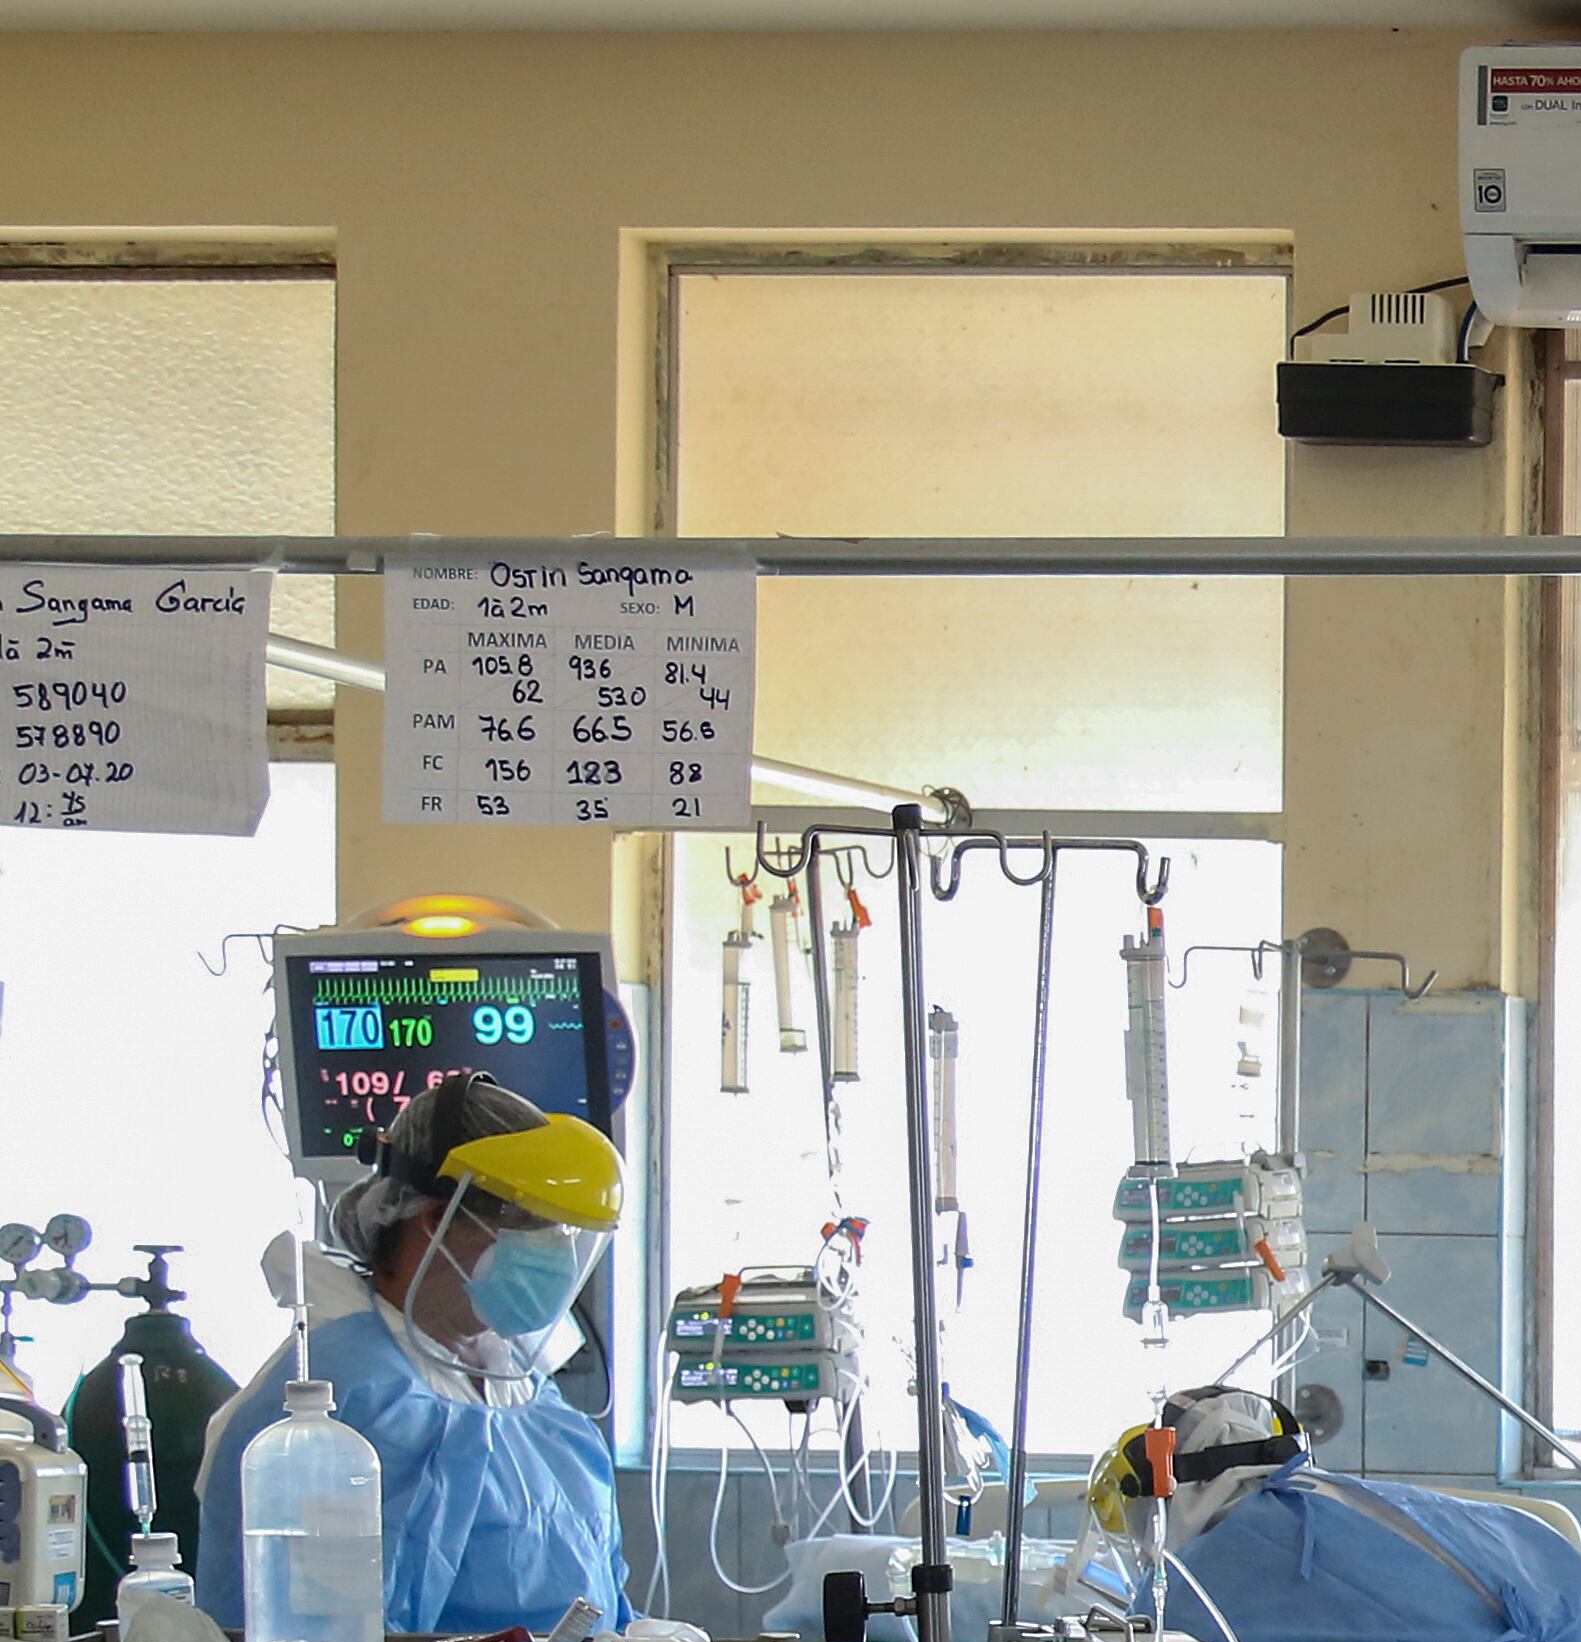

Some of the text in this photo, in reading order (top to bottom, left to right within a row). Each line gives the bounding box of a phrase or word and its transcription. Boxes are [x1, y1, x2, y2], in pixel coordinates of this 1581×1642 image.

[1493, 75, 1528, 87] HASTA
[1530, 74, 1554, 87] 70%
[1535, 99, 1568, 111] DUAL
[412, 567, 478, 580] NOMBRE:
[16, 580, 132, 625] Sangama
[412, 598, 455, 611] EDAD:
[619, 594, 695, 617] SEXO: M
[467, 632, 741, 653] MAXIMA MEDIA MINIMA
[423, 658, 447, 674] PA
[664, 661, 707, 686] 81.4
[13, 681, 126, 711] 589040
[512, 679, 544, 704] 62
[699, 687, 731, 712] 44
[16, 720, 121, 748] 578890
[412, 713, 455, 730] PAM
[422, 755, 444, 771] FC
[485, 758, 531, 783] 156
[421, 795, 701, 821] FR 53 35 21
[321, 1008, 380, 1046] 170
[388, 1018, 433, 1047] 170
[473, 1004, 536, 1046] 99
